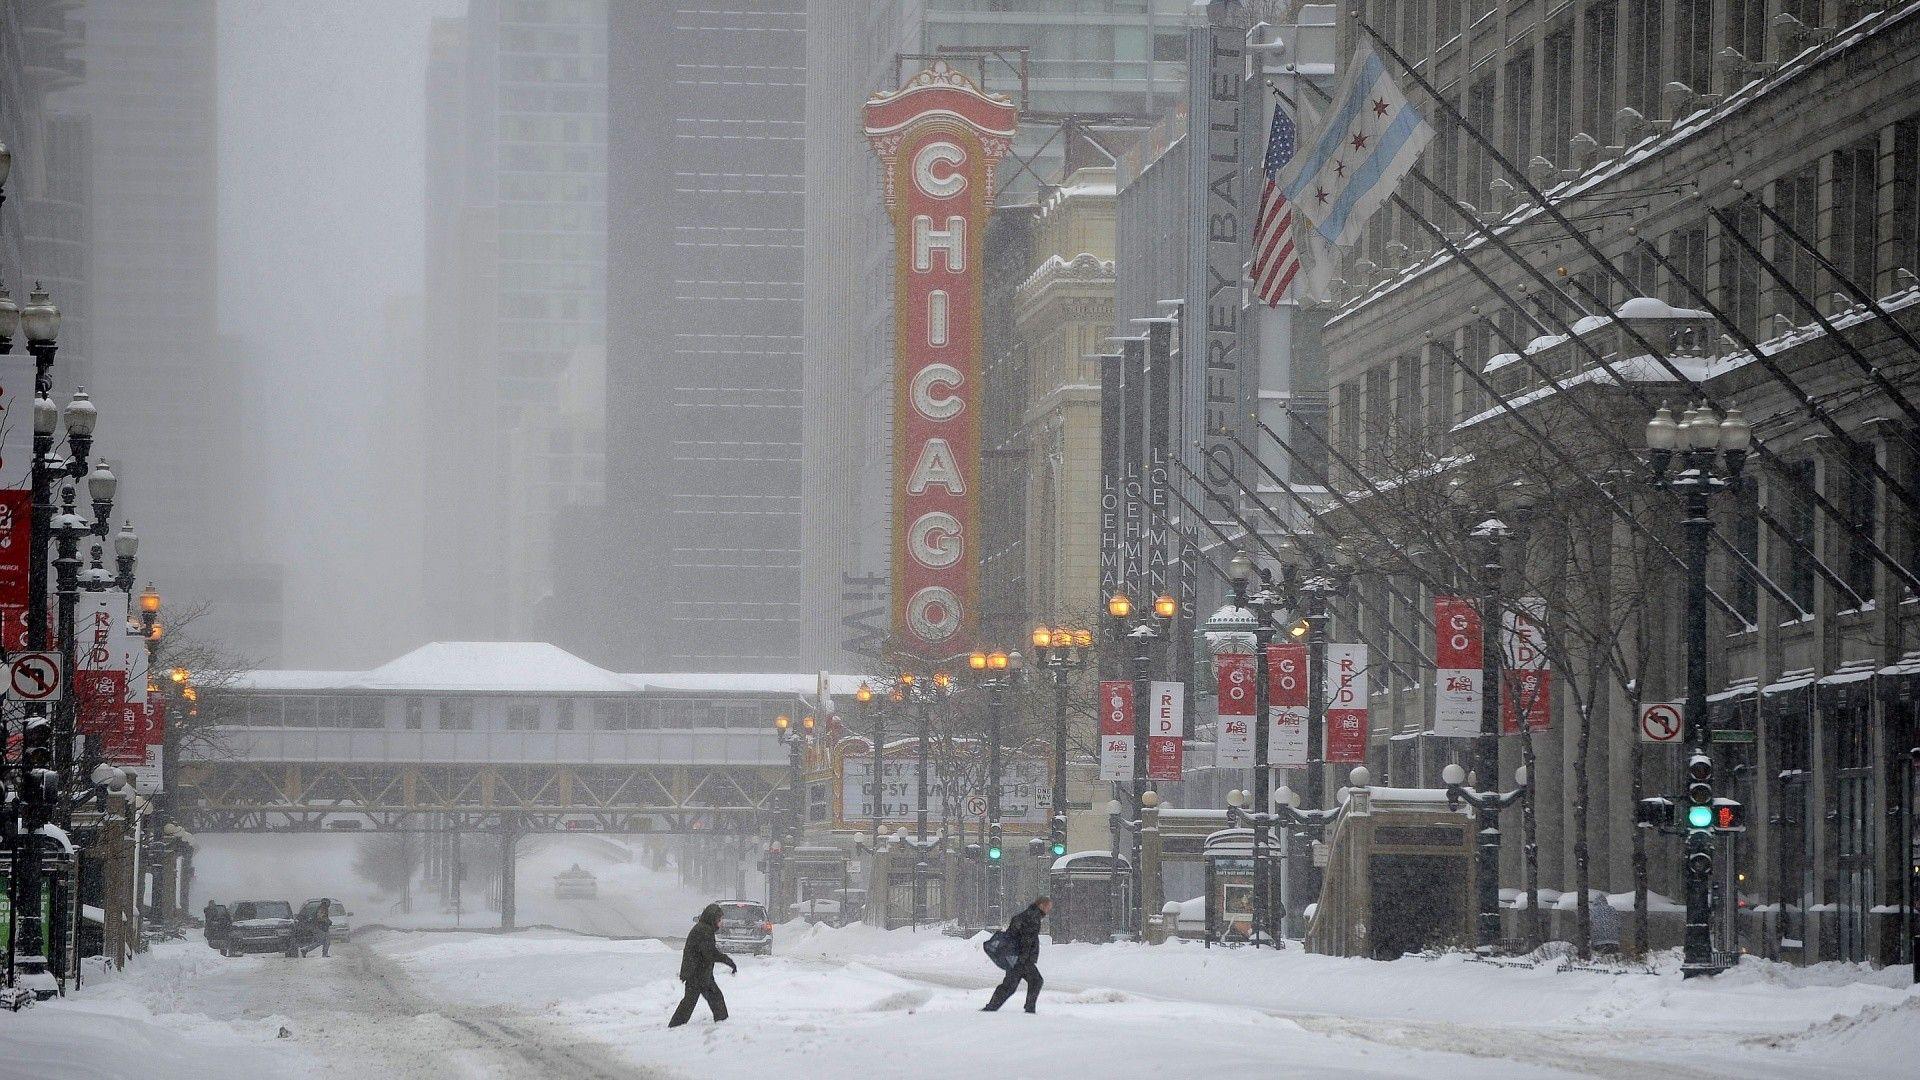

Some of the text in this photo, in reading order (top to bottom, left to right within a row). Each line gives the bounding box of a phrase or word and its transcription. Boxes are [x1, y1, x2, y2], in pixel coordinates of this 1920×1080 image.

[1210, 34, 1240, 243] BALLET
[906, 141, 968, 643] CHICAGO
[93, 611, 110, 663] RED
[1450, 614, 1469, 650] GO
[1229, 670, 1245, 700] GO
[1280, 659, 1296, 690] GO
[1341, 659, 1354, 703] RED
[1160, 694, 1172, 731] RED
